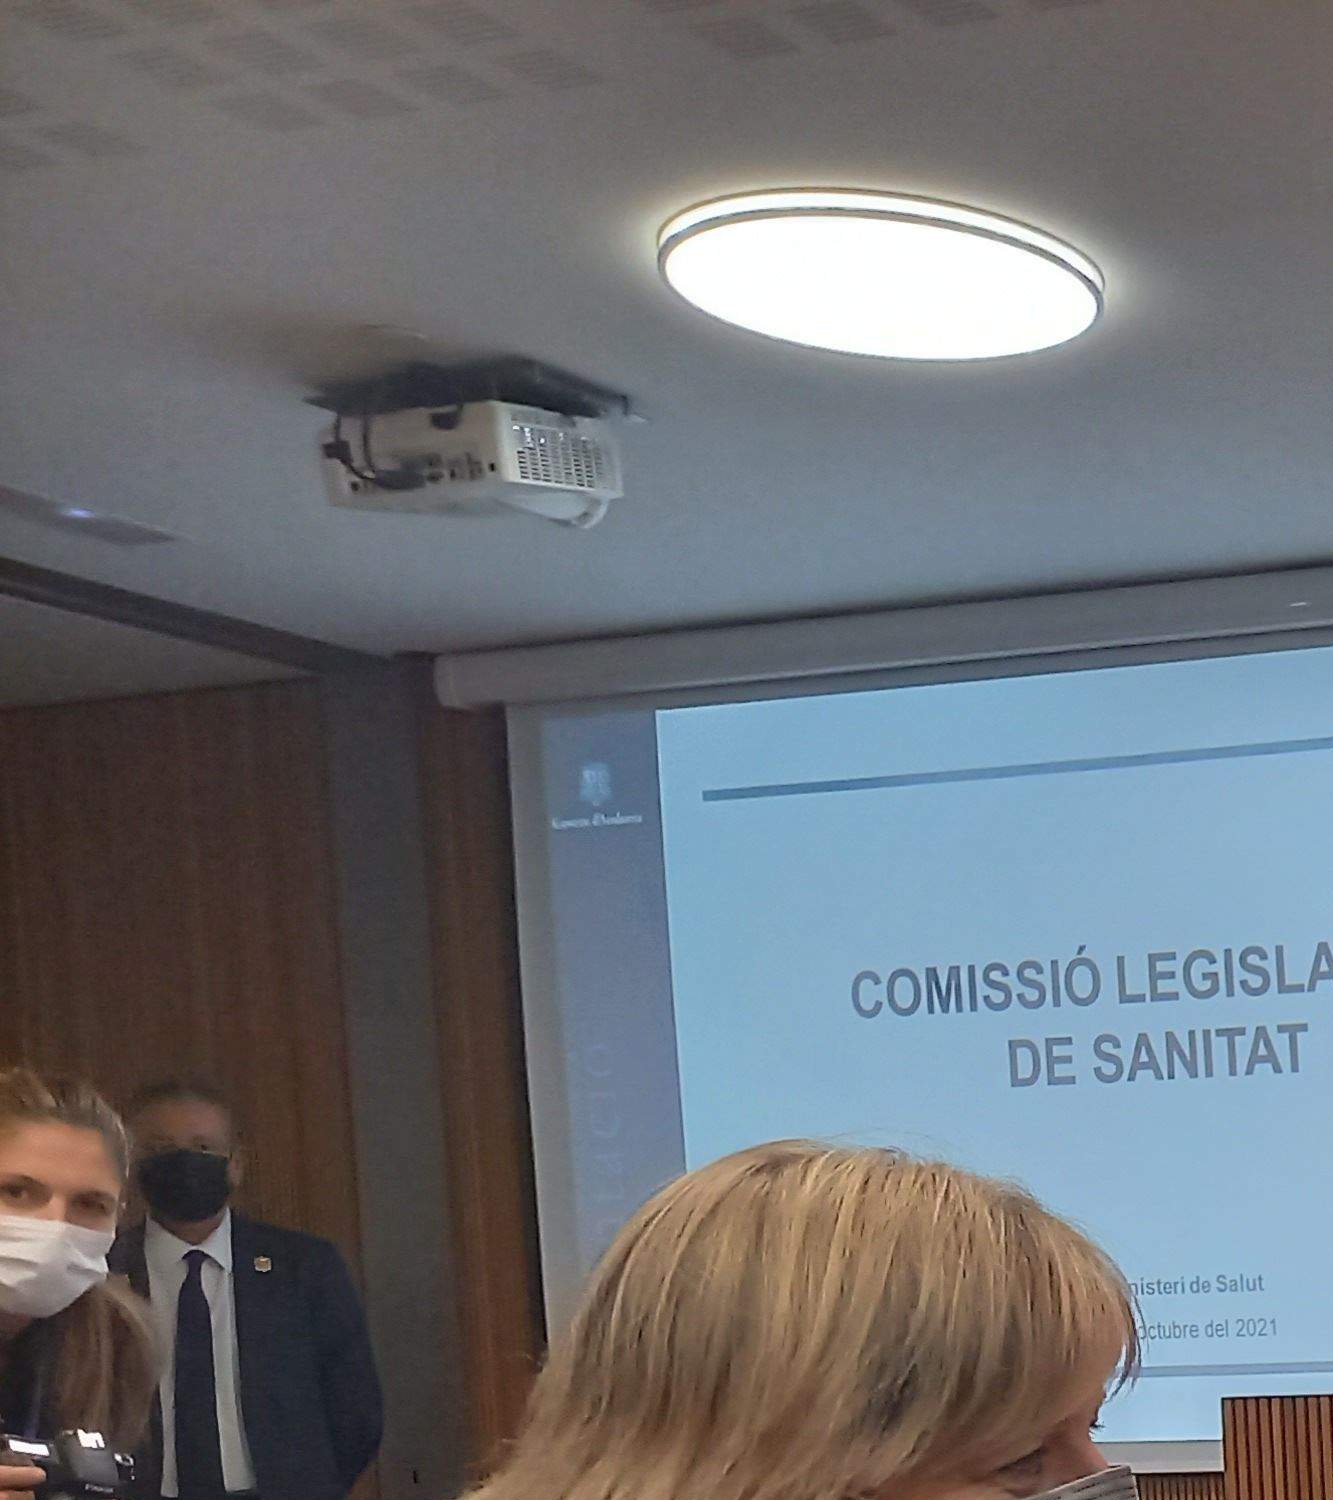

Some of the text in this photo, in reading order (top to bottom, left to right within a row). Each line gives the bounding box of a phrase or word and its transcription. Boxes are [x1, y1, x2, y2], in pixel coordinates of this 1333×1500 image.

[850, 945, 1102, 1019] COMISSIÓ
[1007, 1022, 1310, 1088] DE SANITAT
[1129, 1273, 1265, 1296] nisteri de Salut
[1204, 1318, 1229, 1338] del
[1235, 1317, 1278, 1337] 2021
